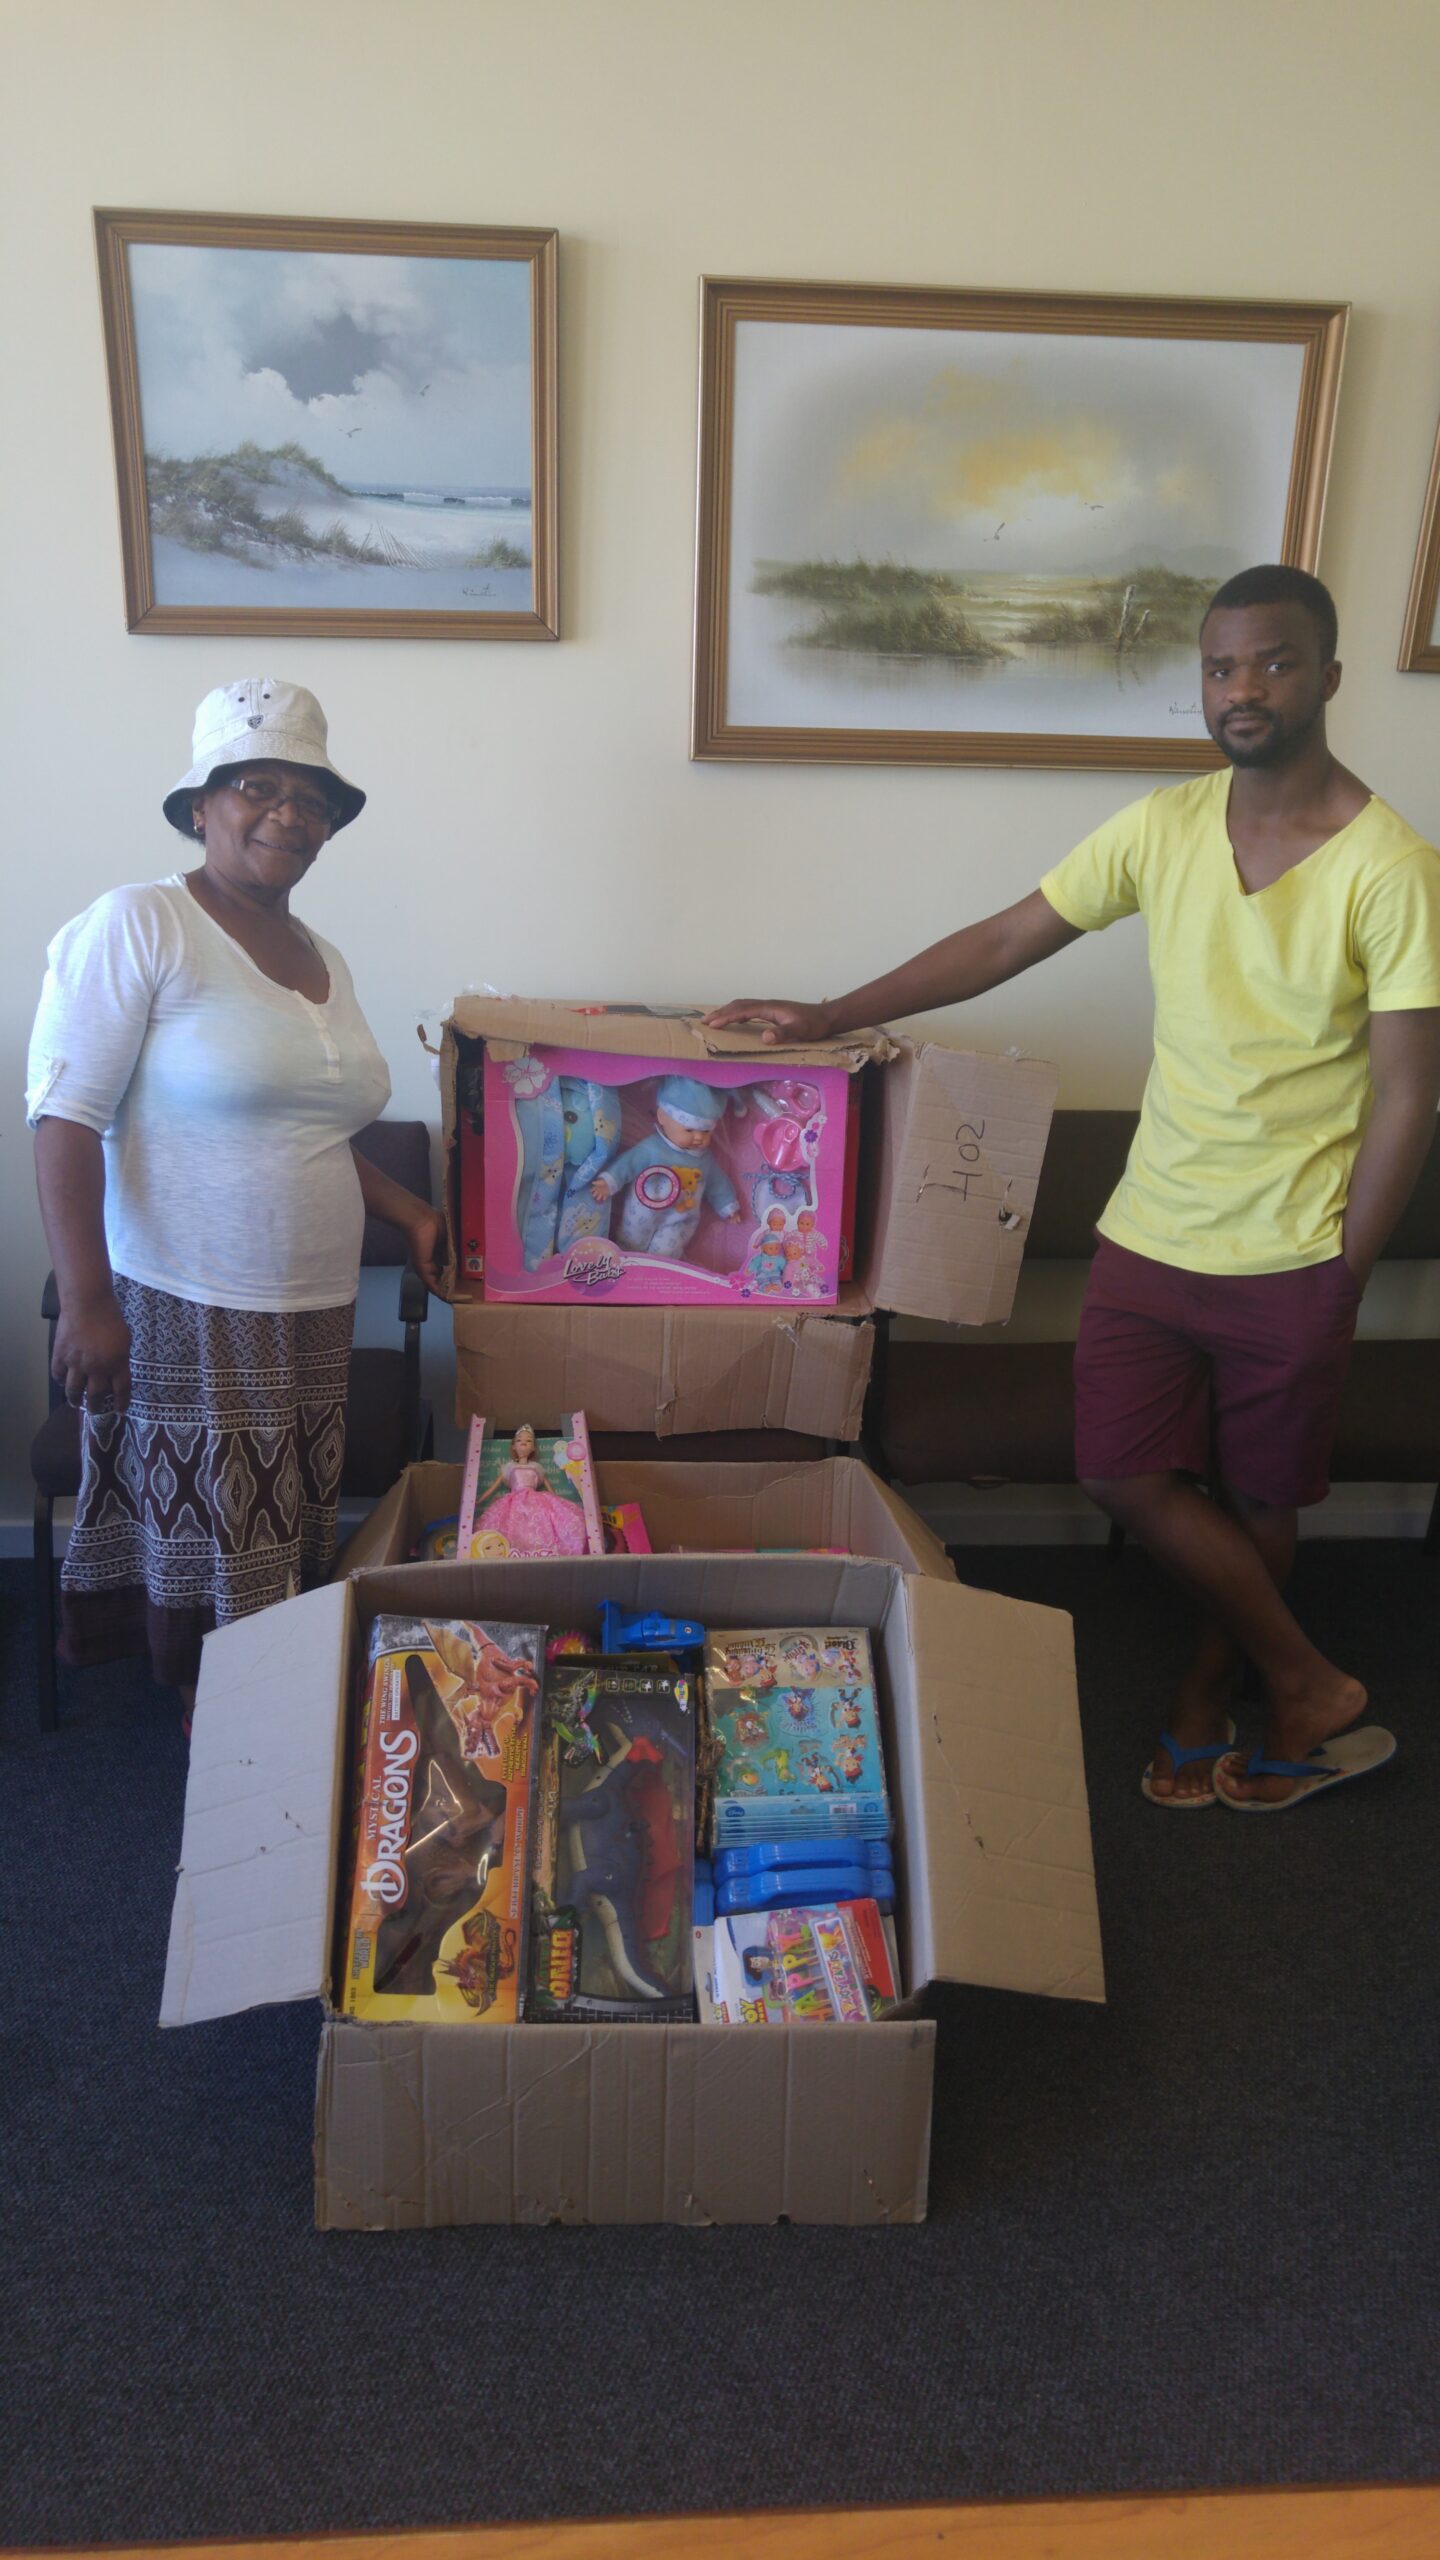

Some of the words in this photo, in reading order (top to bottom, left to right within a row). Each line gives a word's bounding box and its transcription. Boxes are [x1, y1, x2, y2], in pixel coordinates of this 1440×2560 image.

[563, 1255, 612, 1279] Lovely
[381, 1687, 389, 1708] WING
[360, 1730, 418, 1904] DRAGONS
[367, 1775, 382, 1841] MYSTICAL
[739, 1998, 758, 2024] OY
